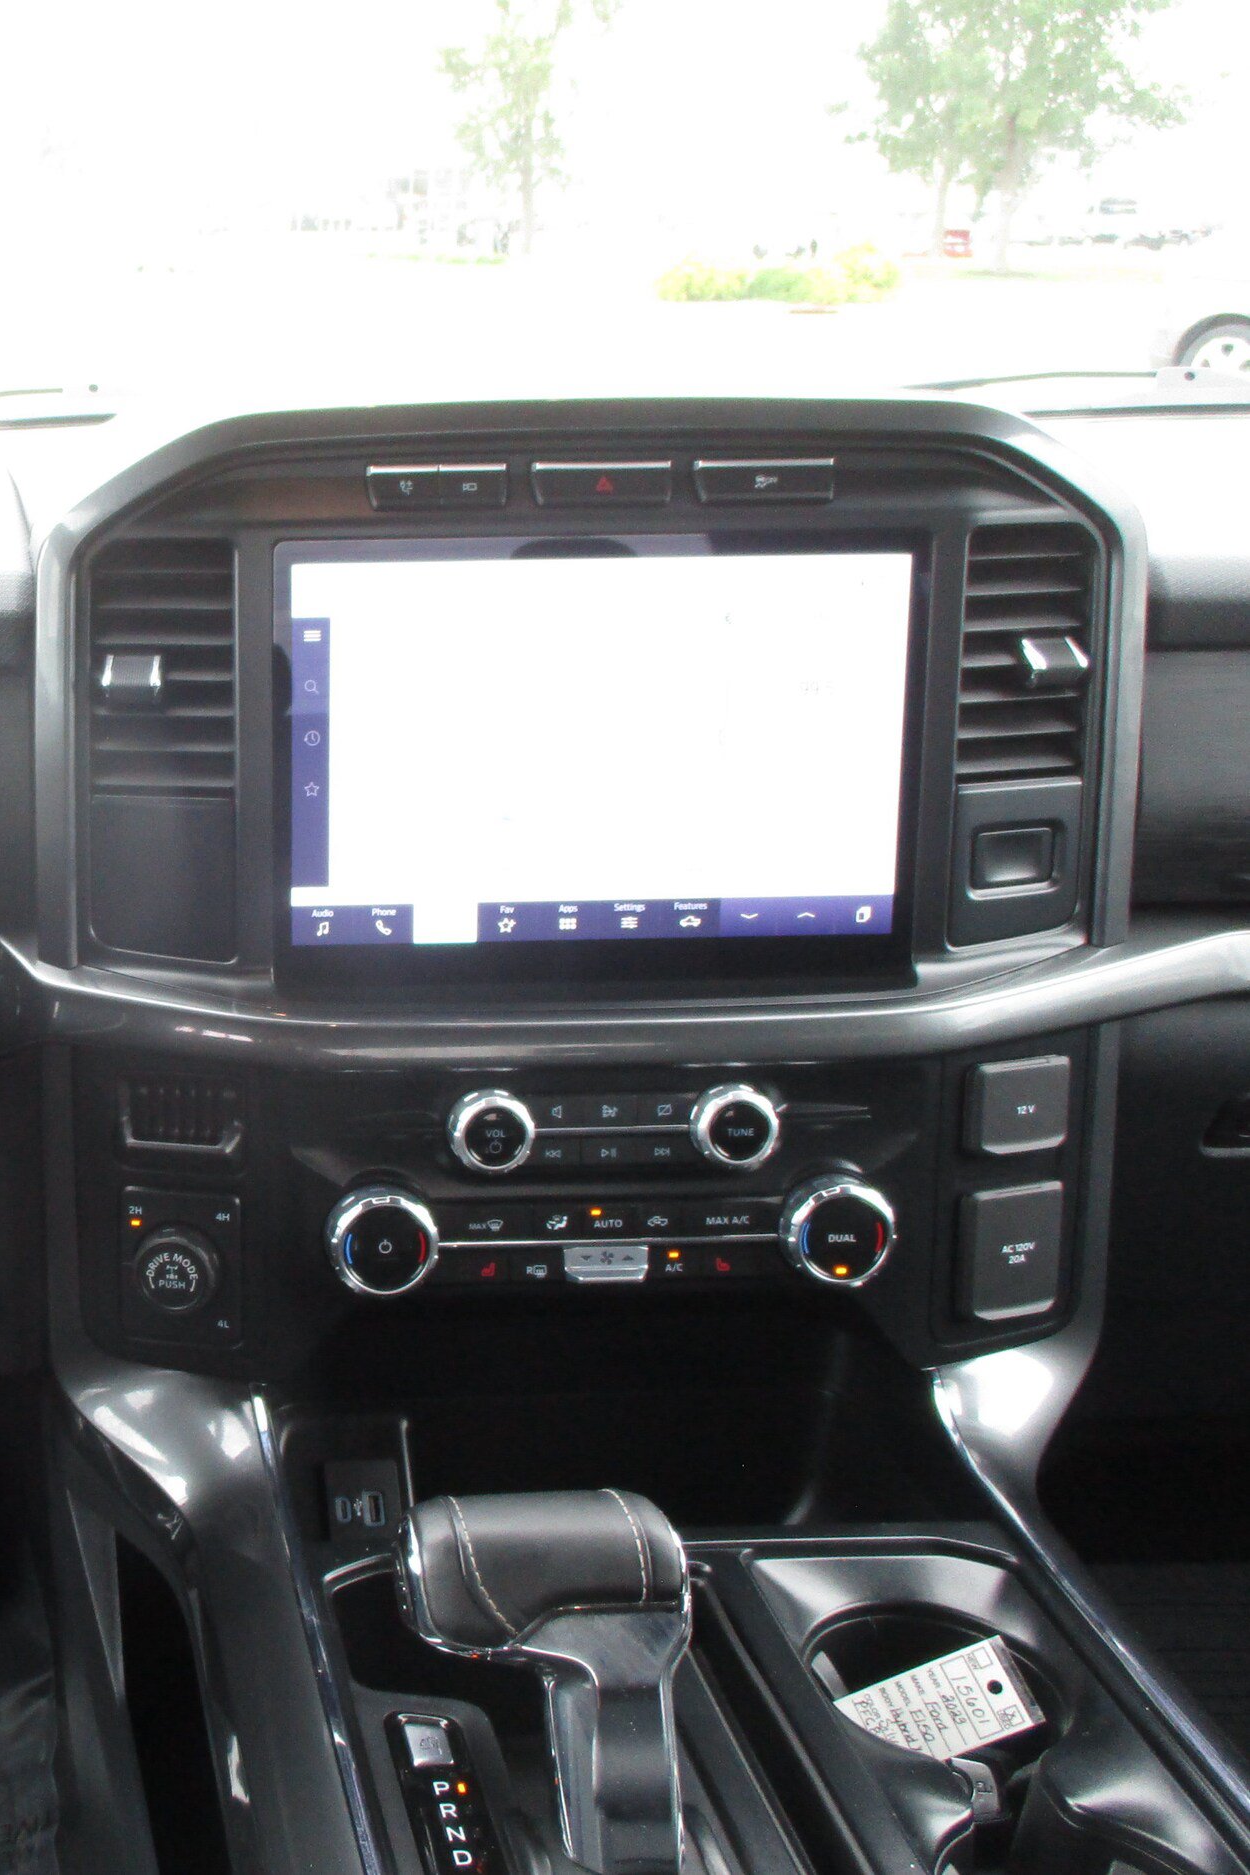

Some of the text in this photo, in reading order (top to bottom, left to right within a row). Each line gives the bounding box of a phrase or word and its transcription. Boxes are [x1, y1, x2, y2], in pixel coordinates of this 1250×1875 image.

[499, 905, 515, 914] Fav
[558, 904, 578, 914] Apps
[613, 903, 646, 913] Settings
[673, 902, 708, 911] Features
[311, 908, 334, 918] Audio
[371, 907, 396, 917] Phone
[485, 1129, 506, 1138] VOL
[727, 1129, 755, 1137] TUNE
[129, 1206, 142, 1214] 2H
[215, 1213, 230, 1221] 4H
[705, 1215, 750, 1226] MAX A/C
[594, 1219, 622, 1228] AUTO
[828, 1233, 856, 1243] DUAL
[146, 1253, 198, 1280] DRIVE MODE
[665, 1263, 683, 1272] A/C
[159, 1280, 185, 1289] PUSH
[217, 1320, 229, 1328] 4L
[925, 1667, 942, 1690] YEAR
[950, 1672, 989, 1728] 15601
[432, 1781, 450, 1796] P
[439, 1803, 458, 1818] R
[445, 1826, 466, 1842] N
[452, 1850, 472, 1866] D
